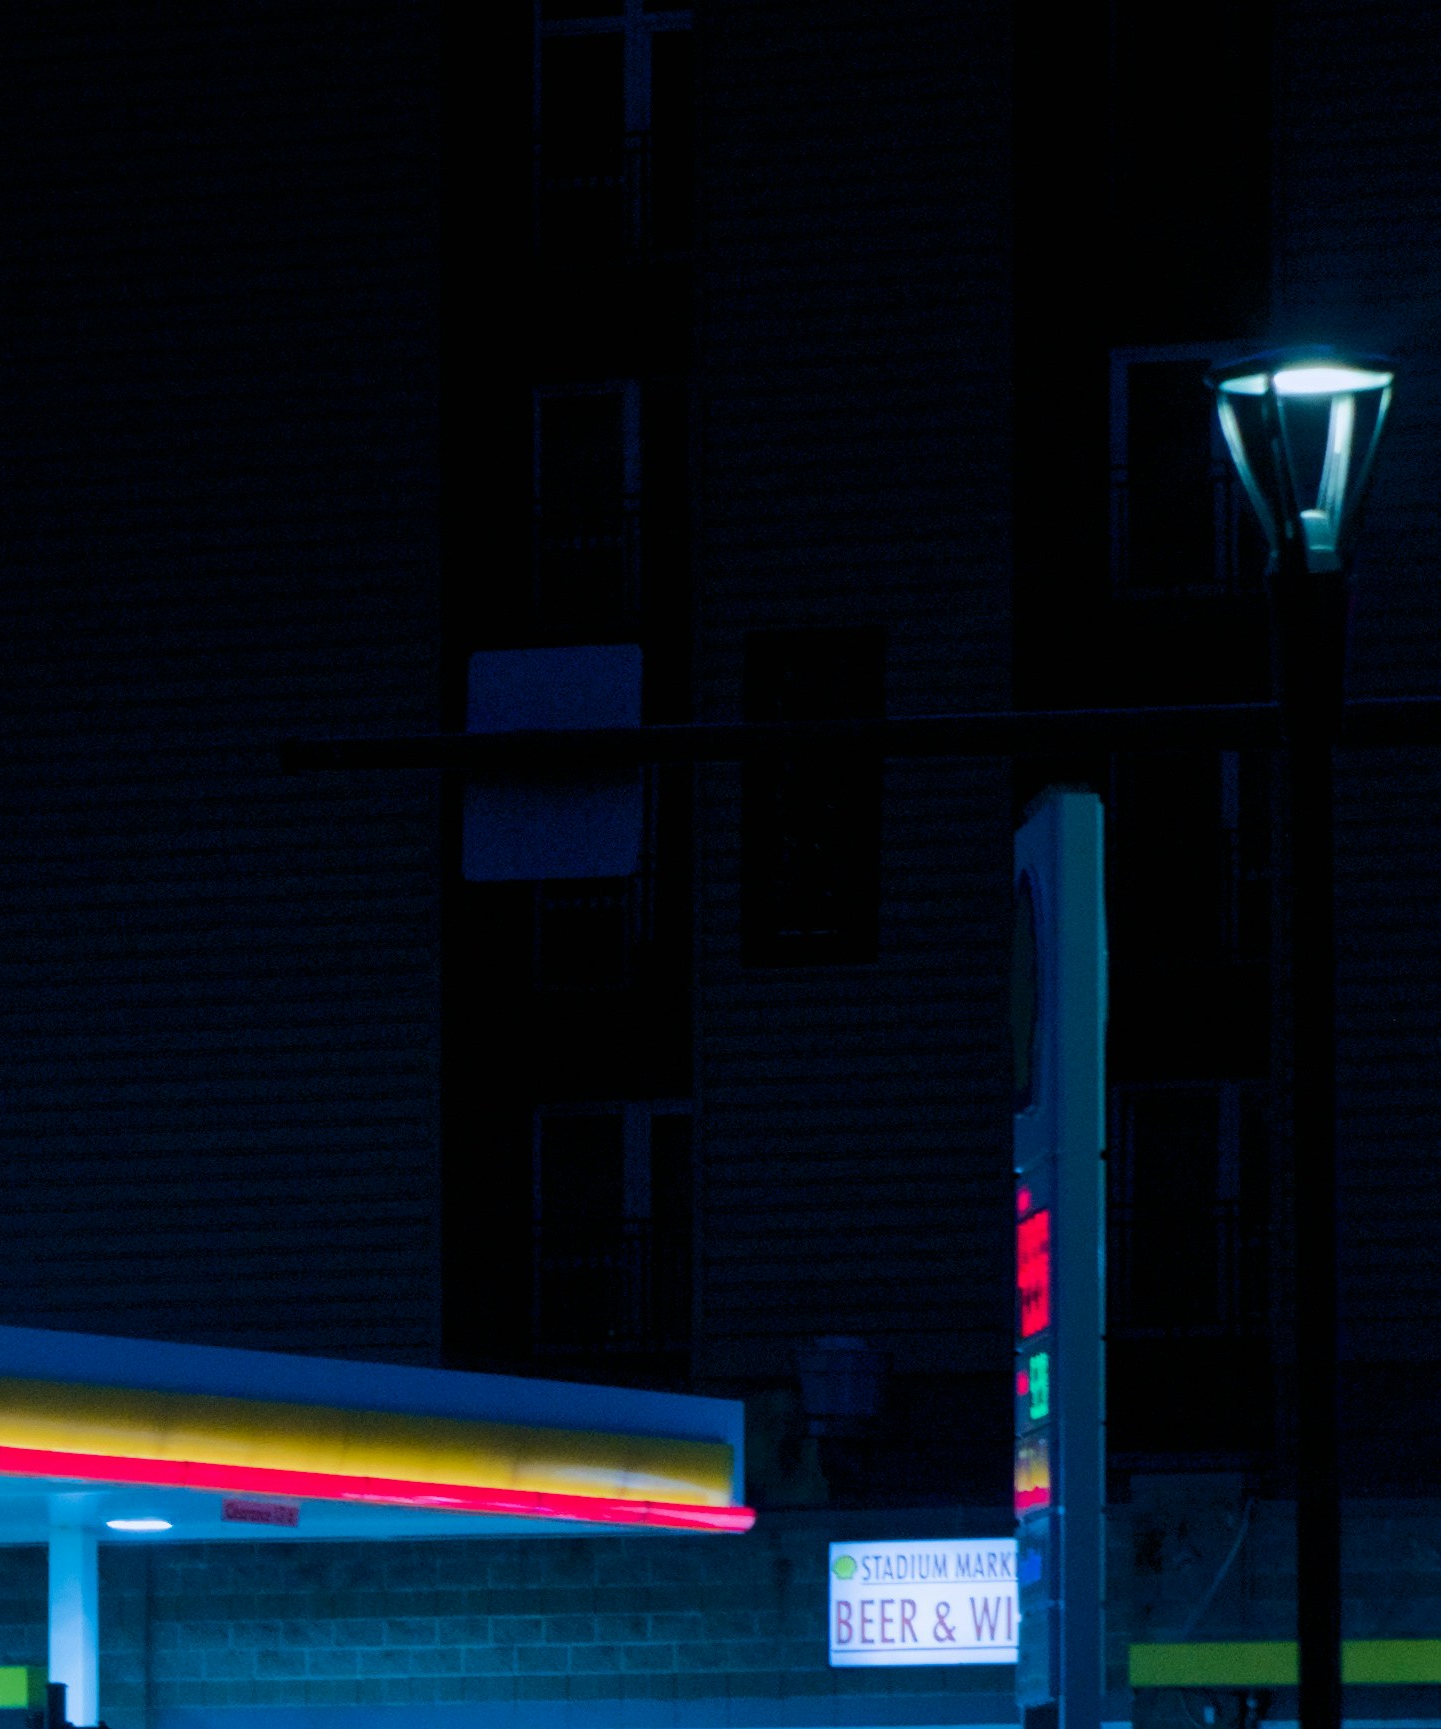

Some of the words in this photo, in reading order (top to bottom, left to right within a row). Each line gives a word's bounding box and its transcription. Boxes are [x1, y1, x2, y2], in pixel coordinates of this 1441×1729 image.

[862, 1552, 948, 1581] STADIUM
[955, 1551, 1018, 1579] MARK
[836, 1599, 918, 1644] BEER
[933, 1601, 956, 1644] &
